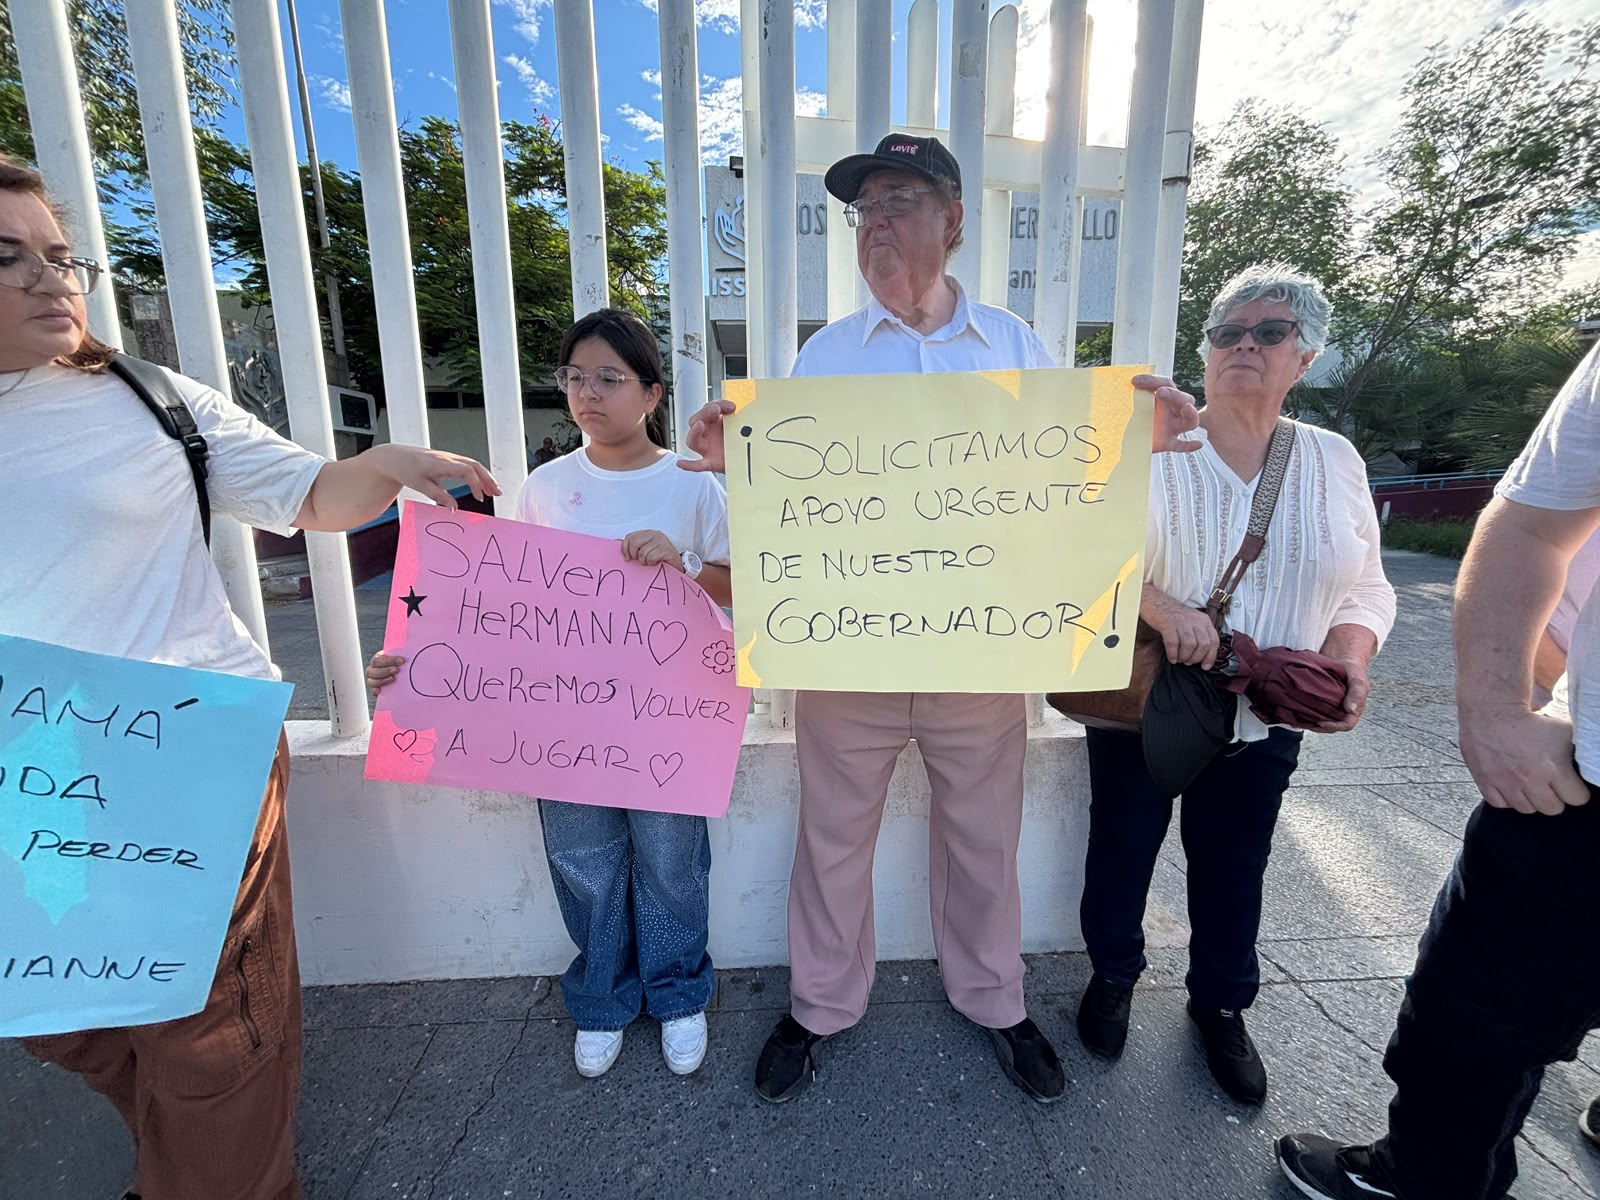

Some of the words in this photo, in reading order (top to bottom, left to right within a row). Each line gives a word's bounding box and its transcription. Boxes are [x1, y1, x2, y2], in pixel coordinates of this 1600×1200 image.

[780, 496, 886, 528] APOYO
[914, 481, 1108, 521] URGENTE
[759, 551, 802, 583] DE
[822, 544, 995, 580] NUESTRO
[0, 674, 199, 749] AMÁ
[629, 684, 735, 724] VOLVER
[445, 728, 468, 757] A
[489, 730, 640, 774] JUGAR
[21, 830, 205, 871] PERDER
